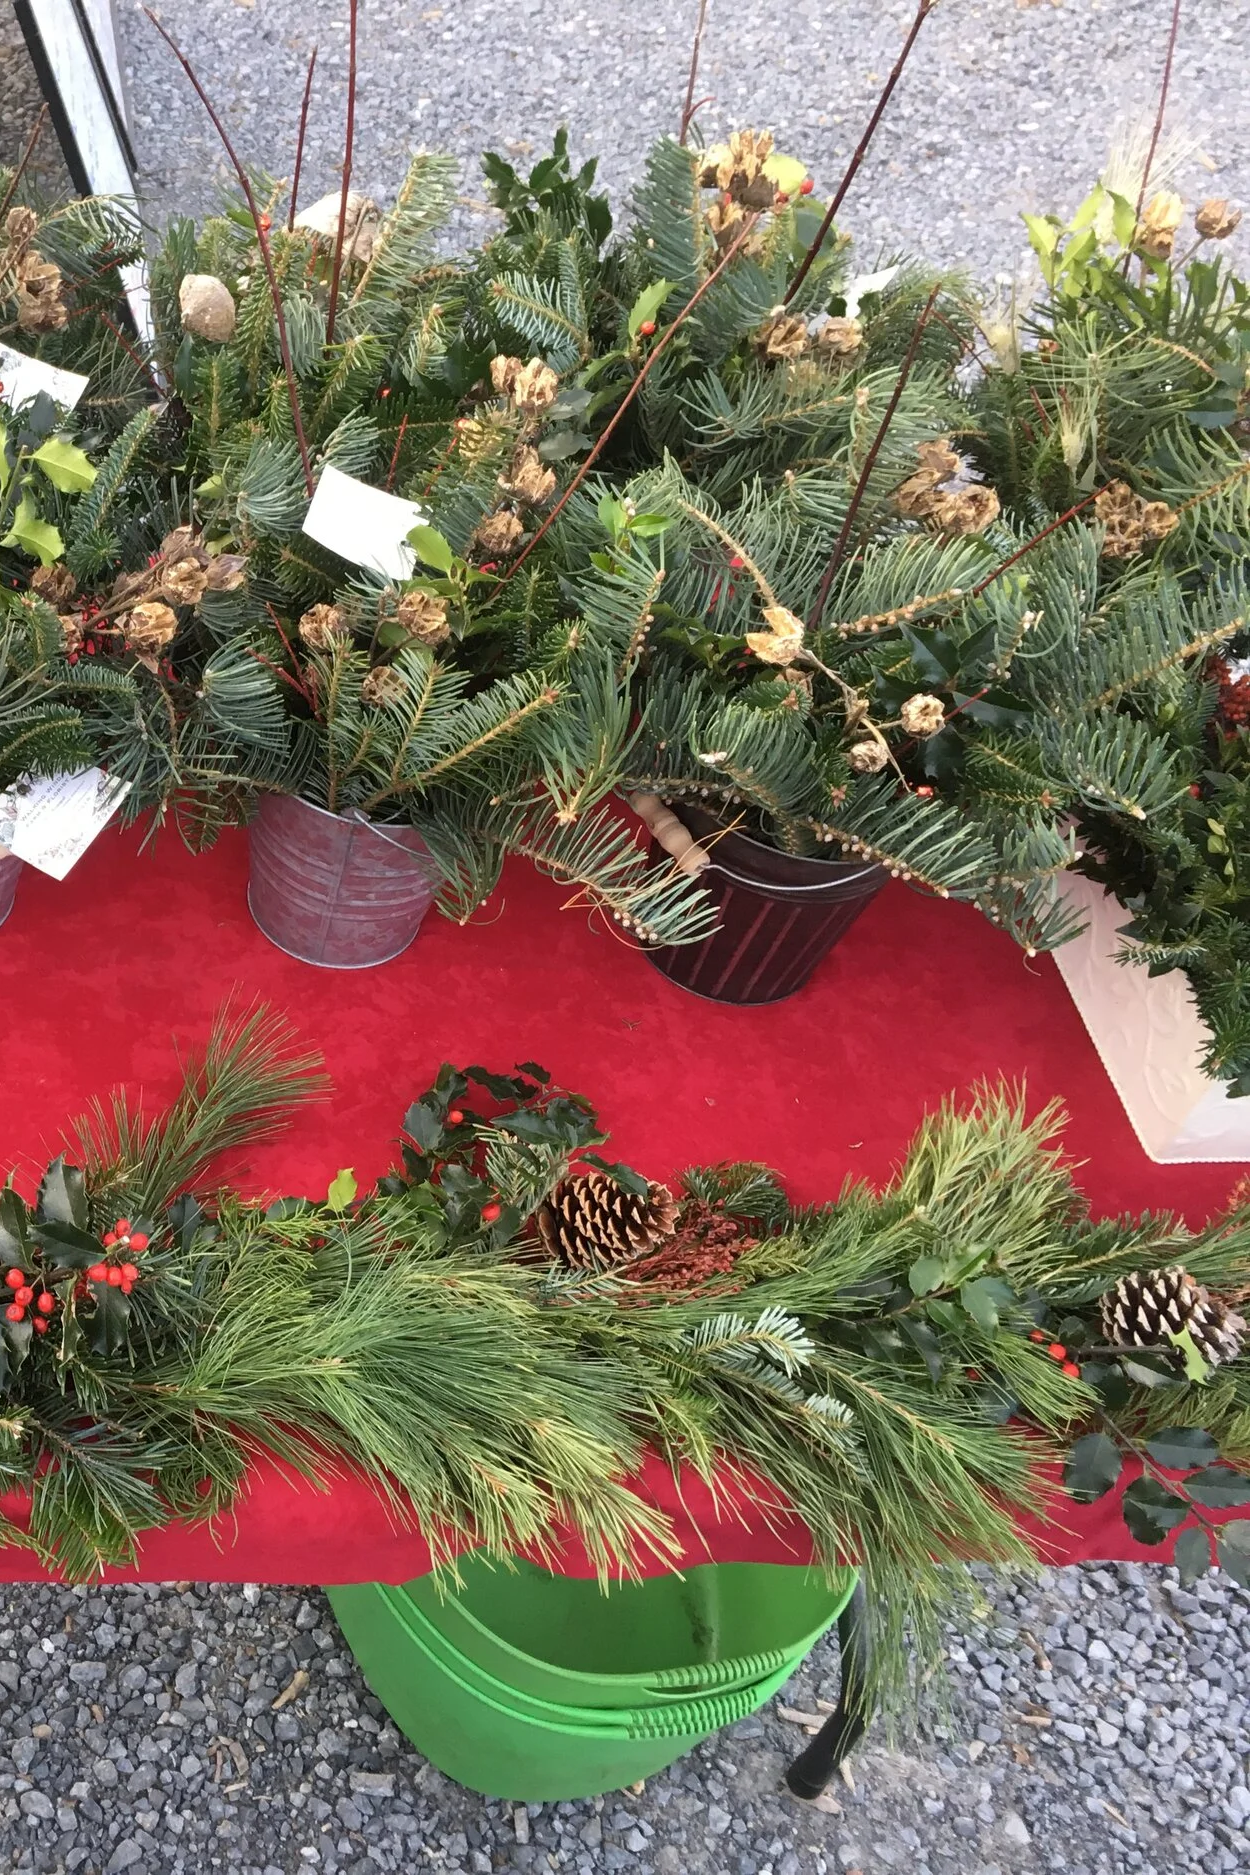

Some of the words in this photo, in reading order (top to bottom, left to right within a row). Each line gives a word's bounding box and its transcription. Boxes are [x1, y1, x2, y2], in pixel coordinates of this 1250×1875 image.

[21, 794, 46, 822] WALKING
[46, 776, 63, 793] WIND
[47, 778, 70, 804] FLORIST
